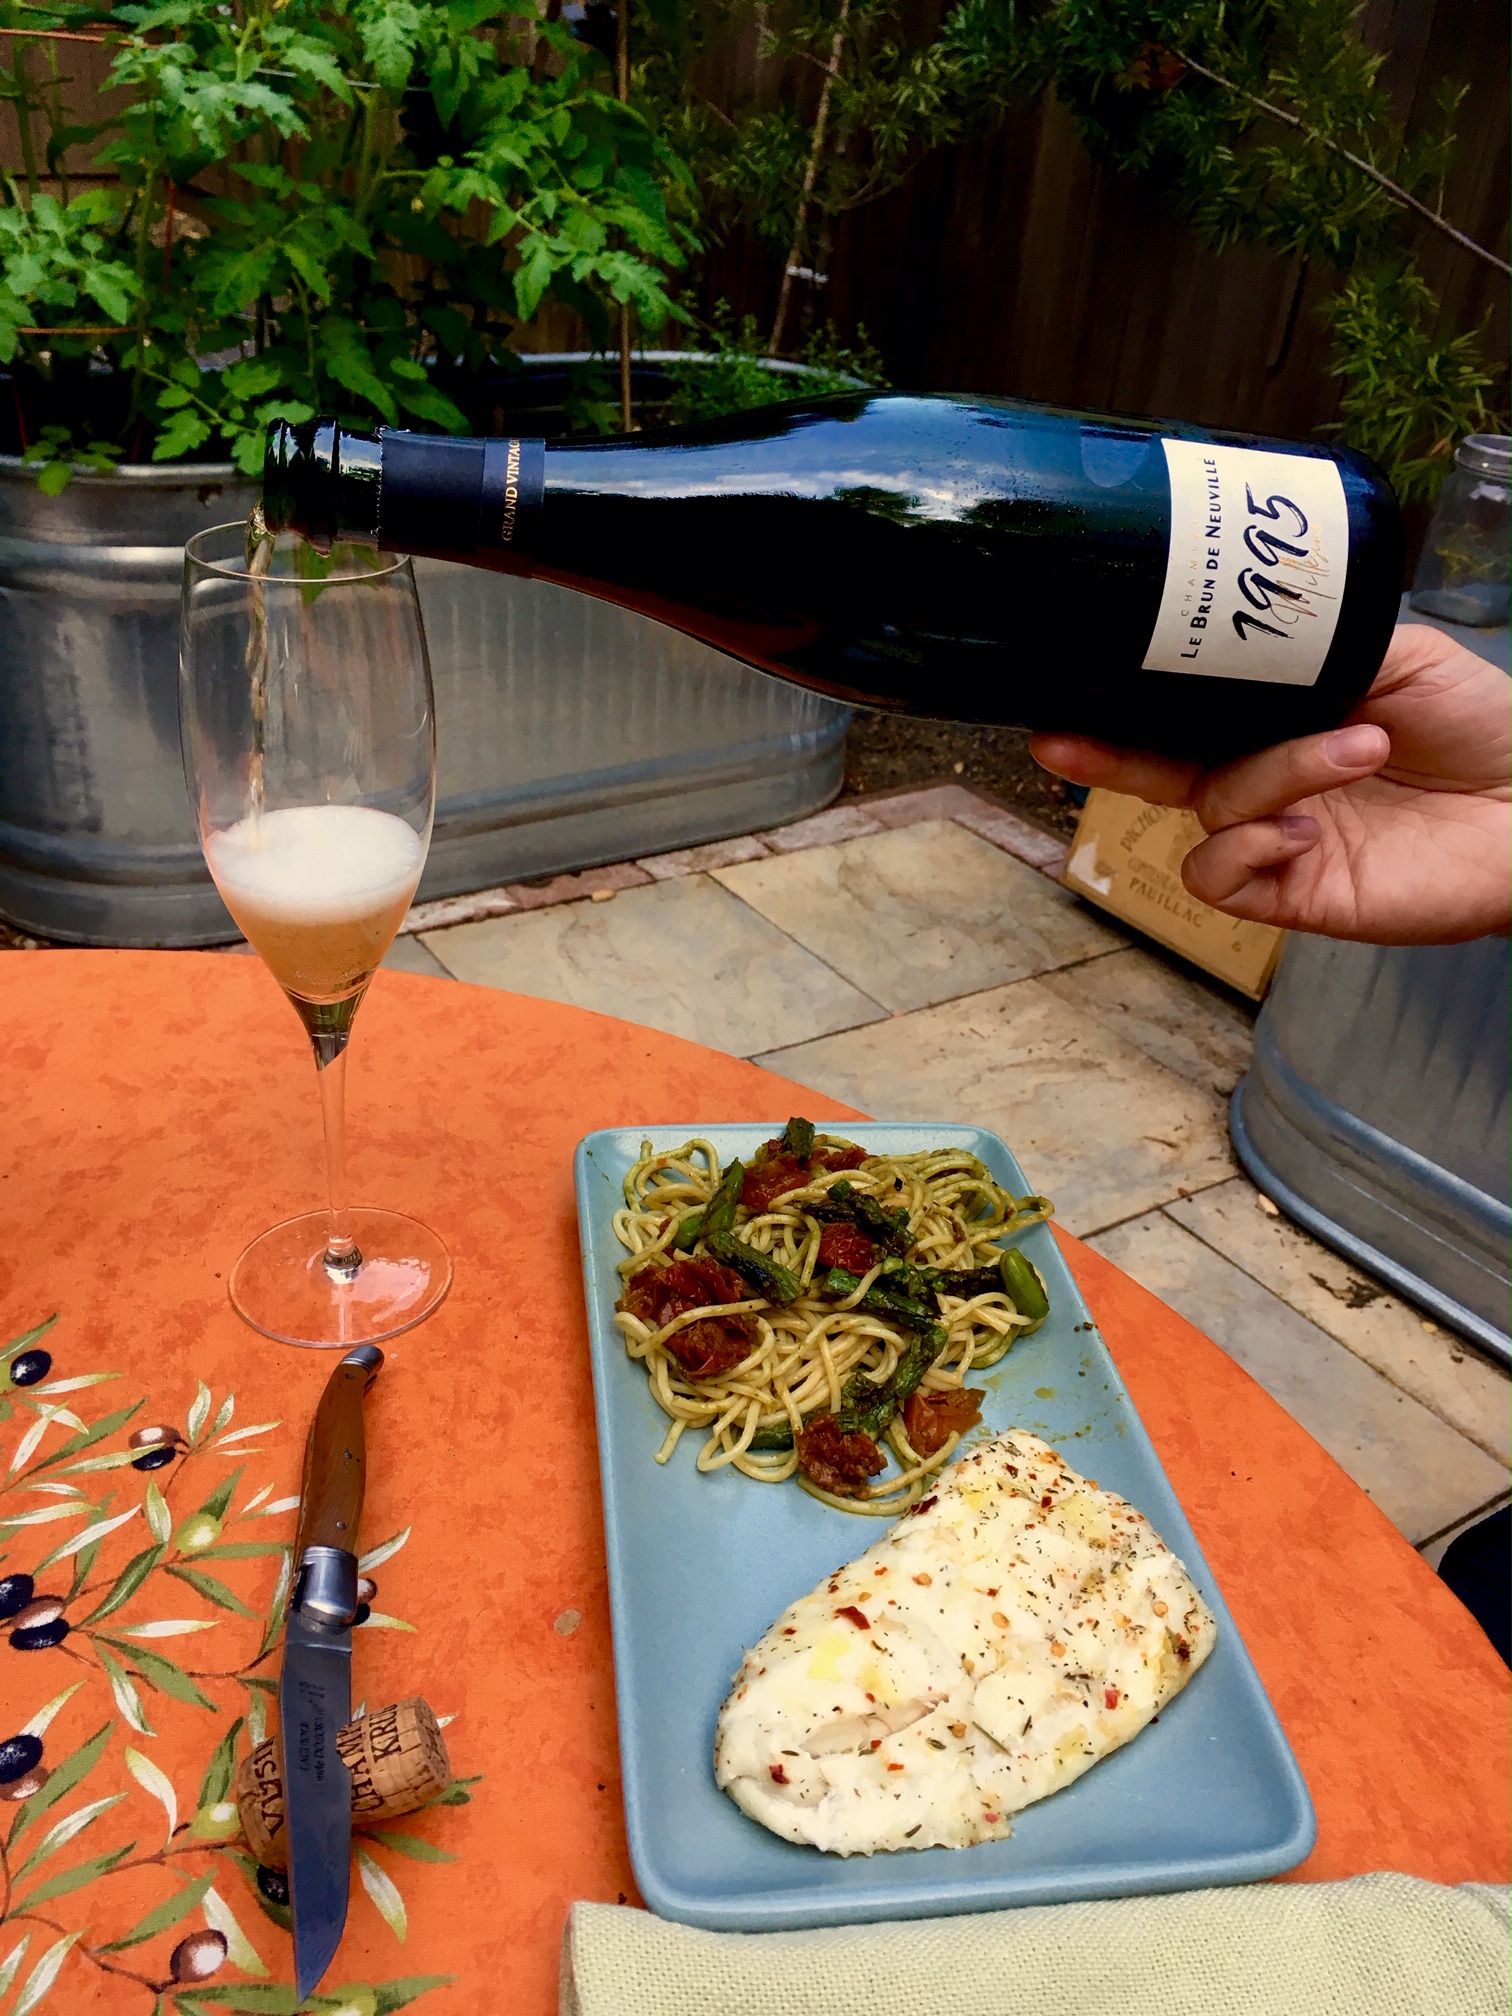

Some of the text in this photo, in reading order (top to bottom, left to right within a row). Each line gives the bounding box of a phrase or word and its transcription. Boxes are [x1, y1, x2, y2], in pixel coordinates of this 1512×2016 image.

[502, 487, 518, 541] GRAND
[1181, 495, 1202, 617] CHAMPAGN
[1232, 481, 1309, 641] 1995
[1129, 876, 1203, 929] PAUILLAC
